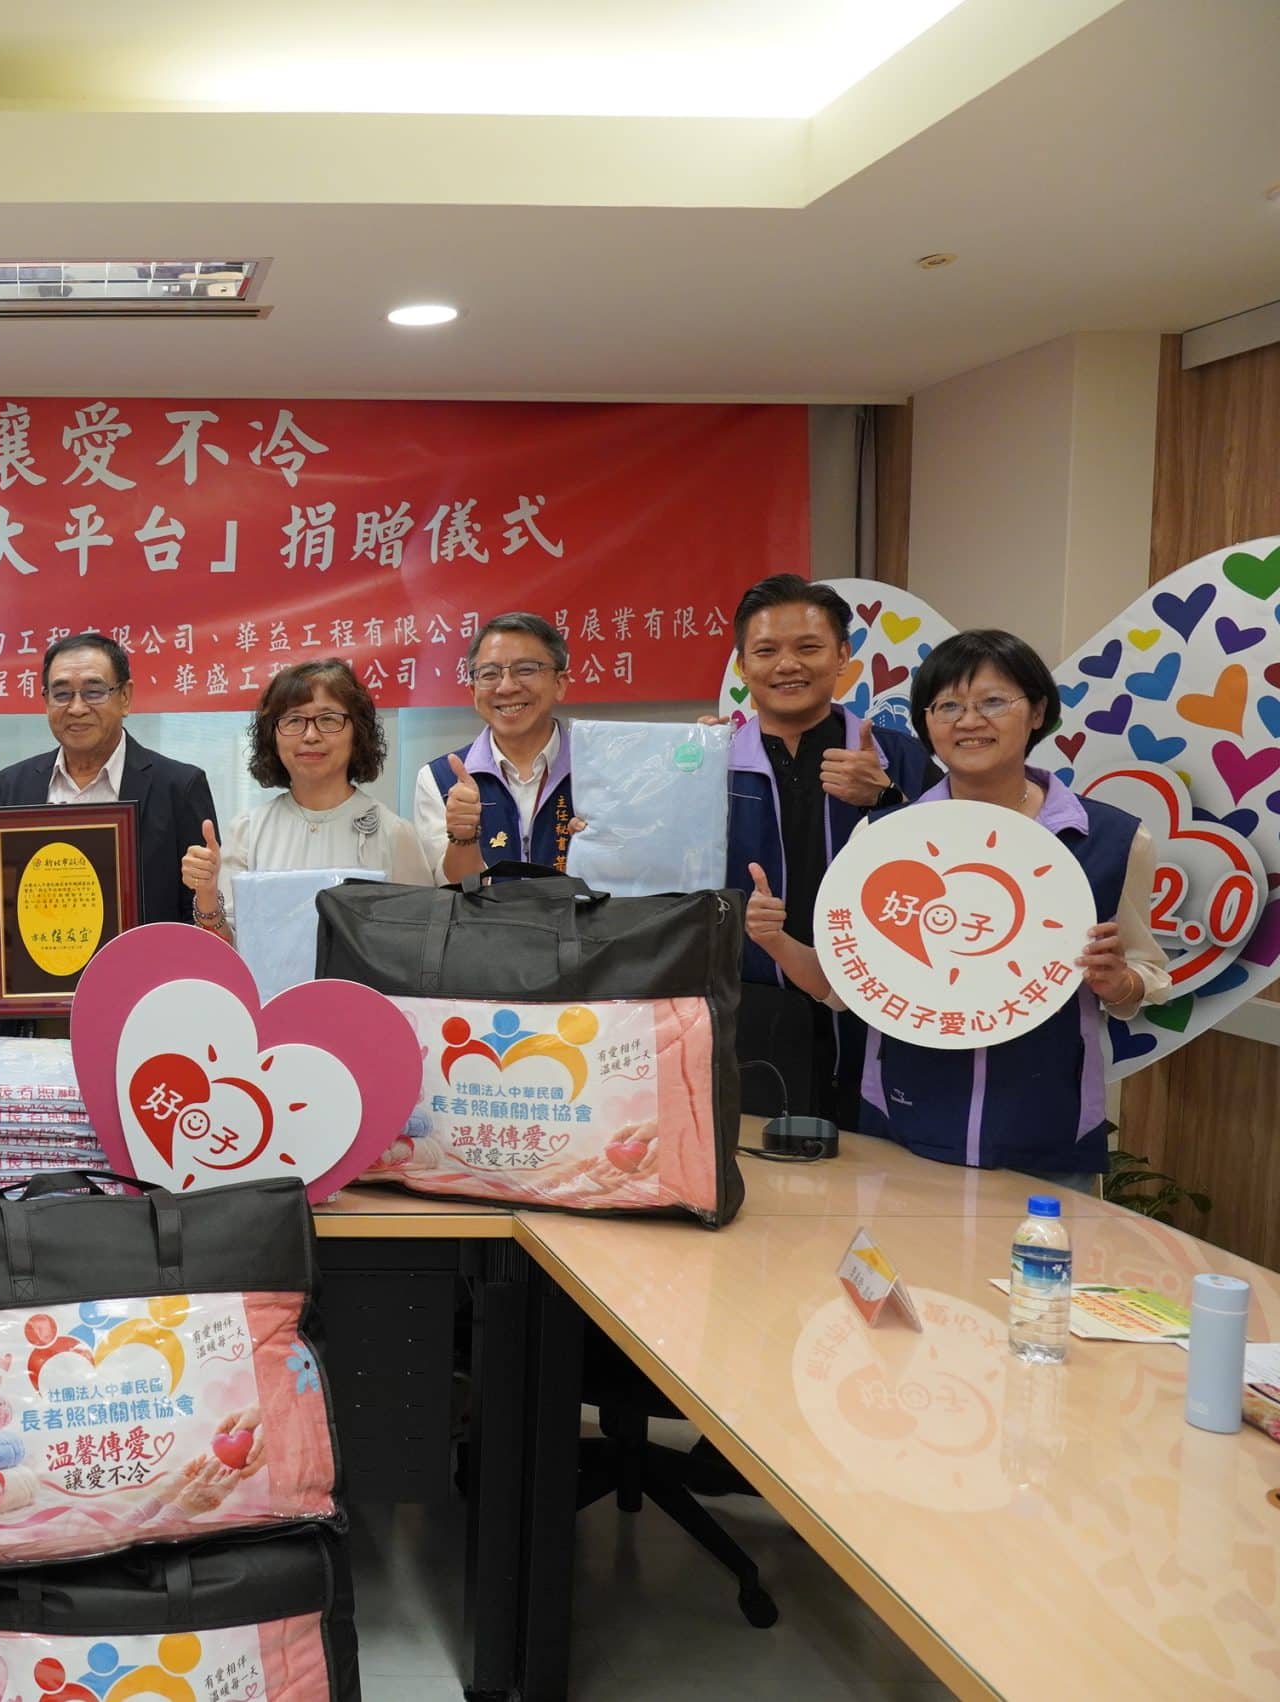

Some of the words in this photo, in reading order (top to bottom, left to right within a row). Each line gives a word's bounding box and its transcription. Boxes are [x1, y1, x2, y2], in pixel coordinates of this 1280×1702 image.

[1150, 865, 1254, 944] 2.0
[826, 906, 1073, 1036] 新北市好日子愛心大平台
[455, 1081, 564, 1100] 社團法人中華民國
[431, 1094, 593, 1123] 長者照顧關懷協會
[464, 1147, 545, 1168] 讓愛不冷
[21, 1393, 196, 1432] 長者照顧關懷協會
[63, 1460, 151, 1491] 讓愛不冷
